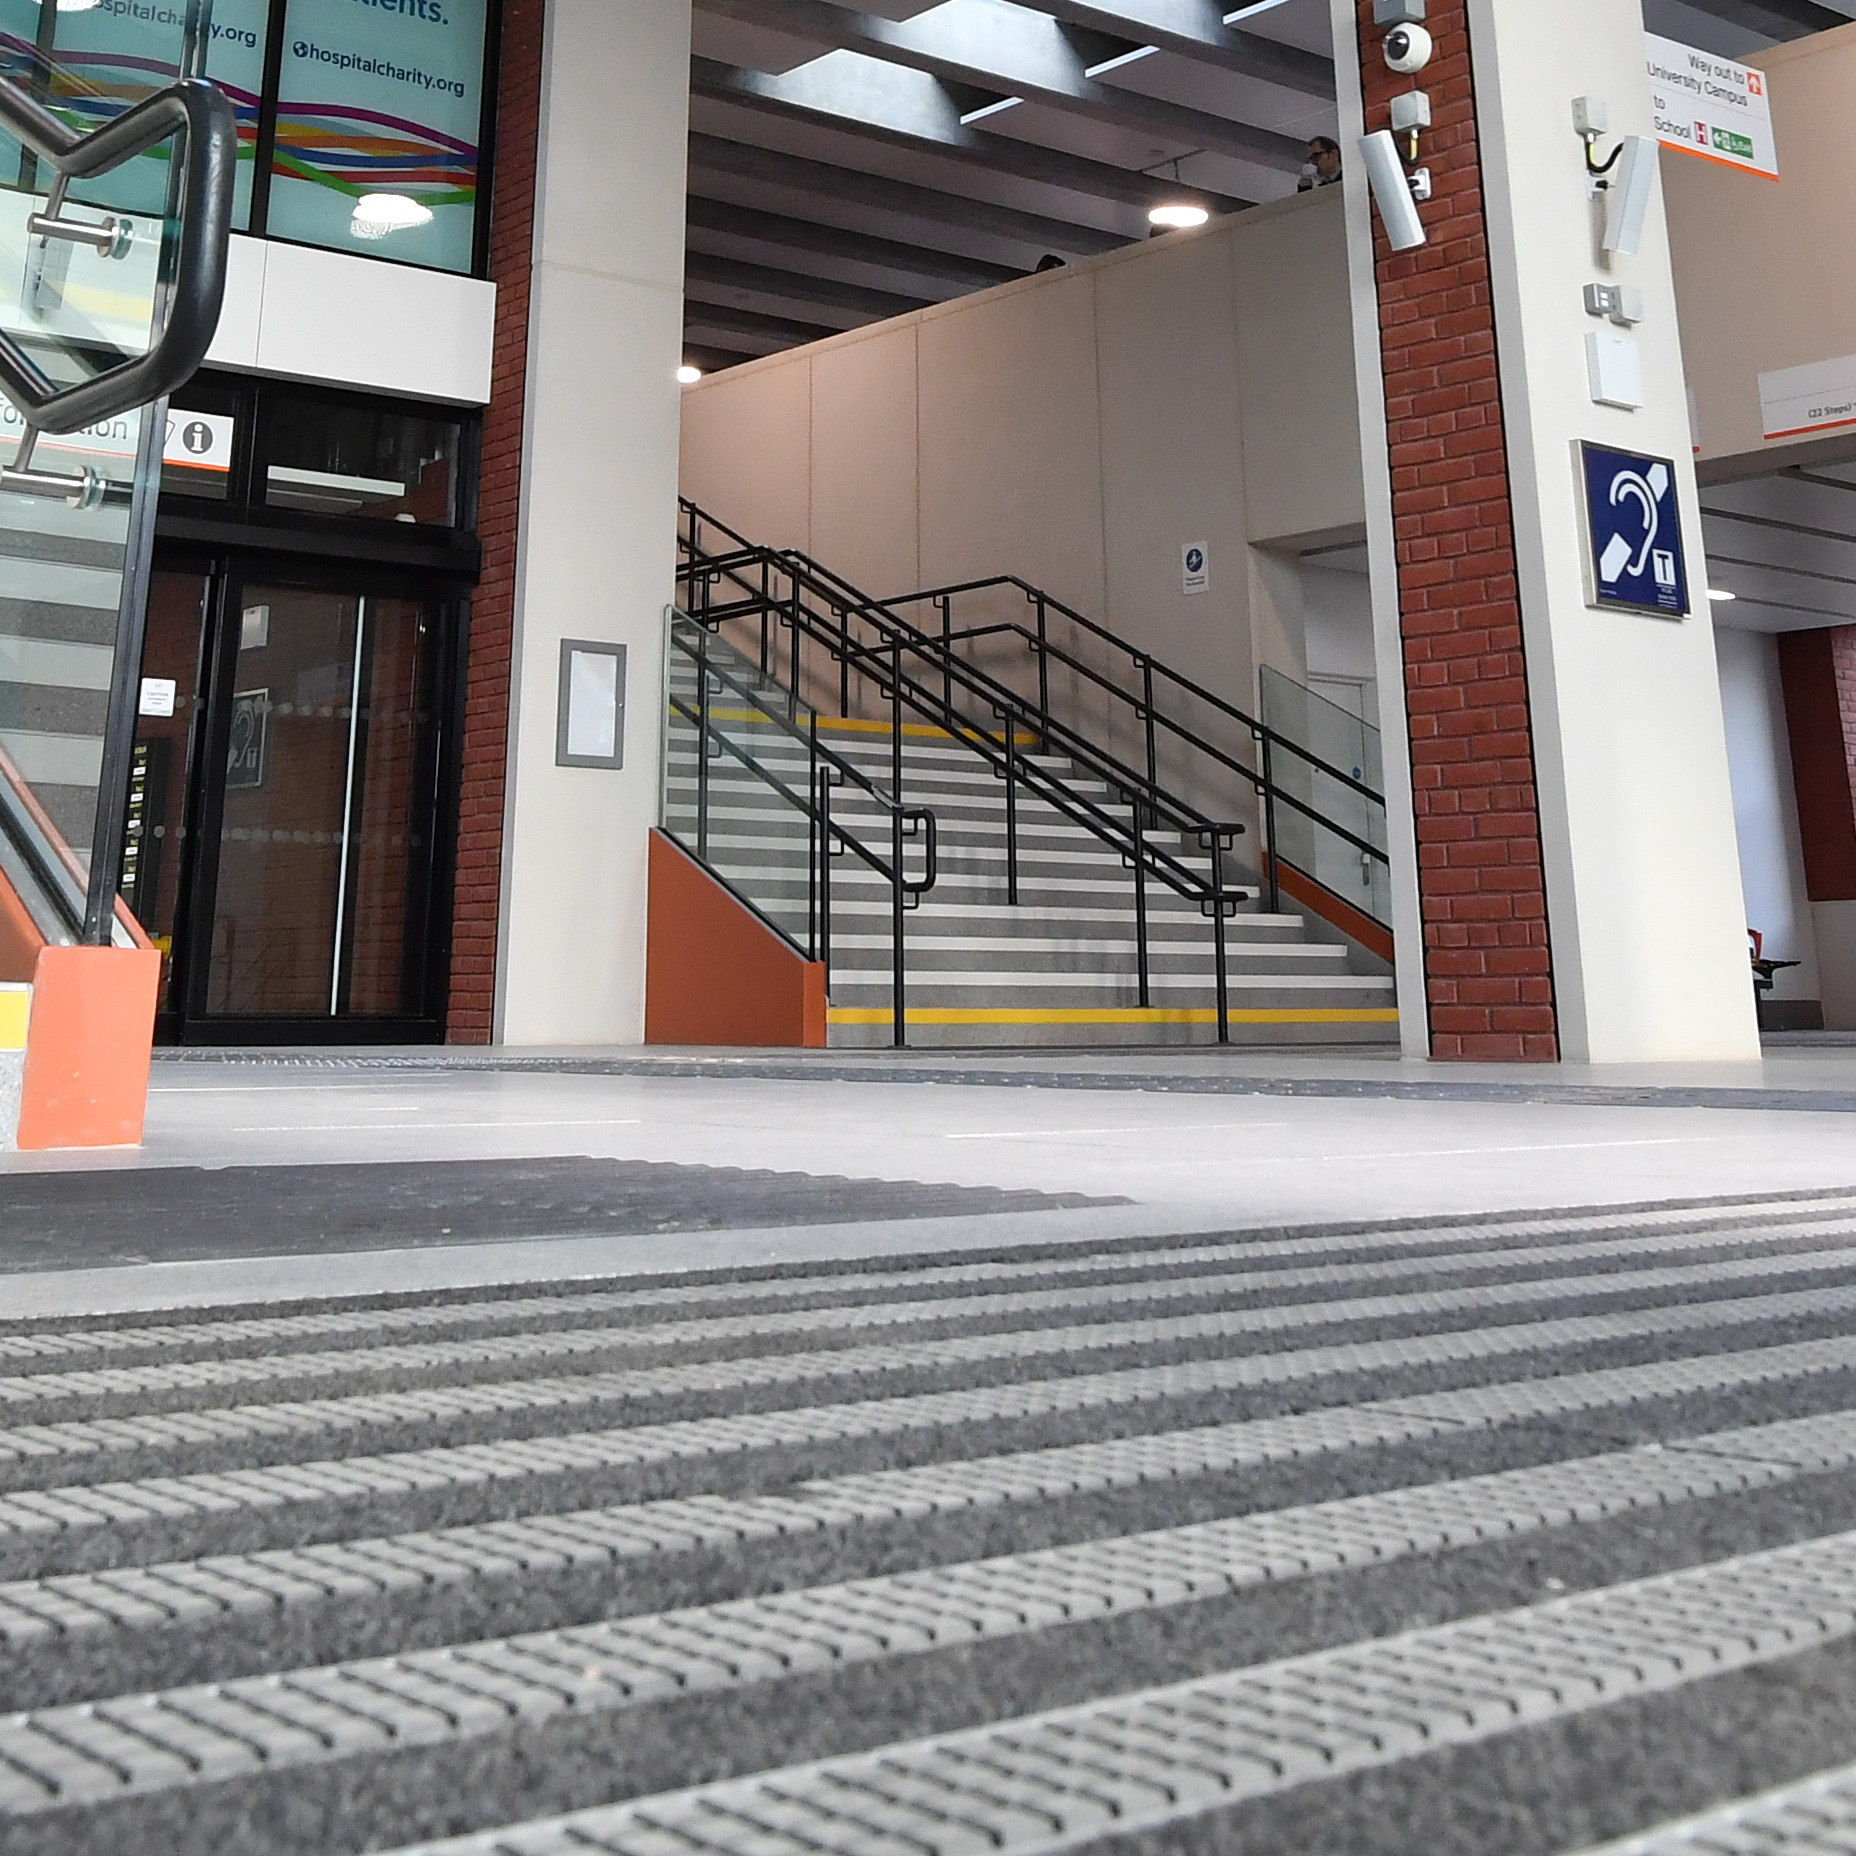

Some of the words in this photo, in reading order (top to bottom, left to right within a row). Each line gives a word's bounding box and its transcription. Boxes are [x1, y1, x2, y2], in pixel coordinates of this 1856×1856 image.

[309, 43, 465, 99] hospitalcharity.org
[1646, 61, 1703, 95] University
[1704, 81, 1748, 107] Campus
[1688, 53, 1713, 77] Way
[1714, 65, 1732, 80] out
[1733, 69, 1745, 85] to
[1653, 94, 1666, 110] to
[1653, 116, 1691, 139] School
[1808, 405, 1823, 419] (22
[1823, 403, 1852, 417] Steps)
[1656, 552, 1670, 582] T
